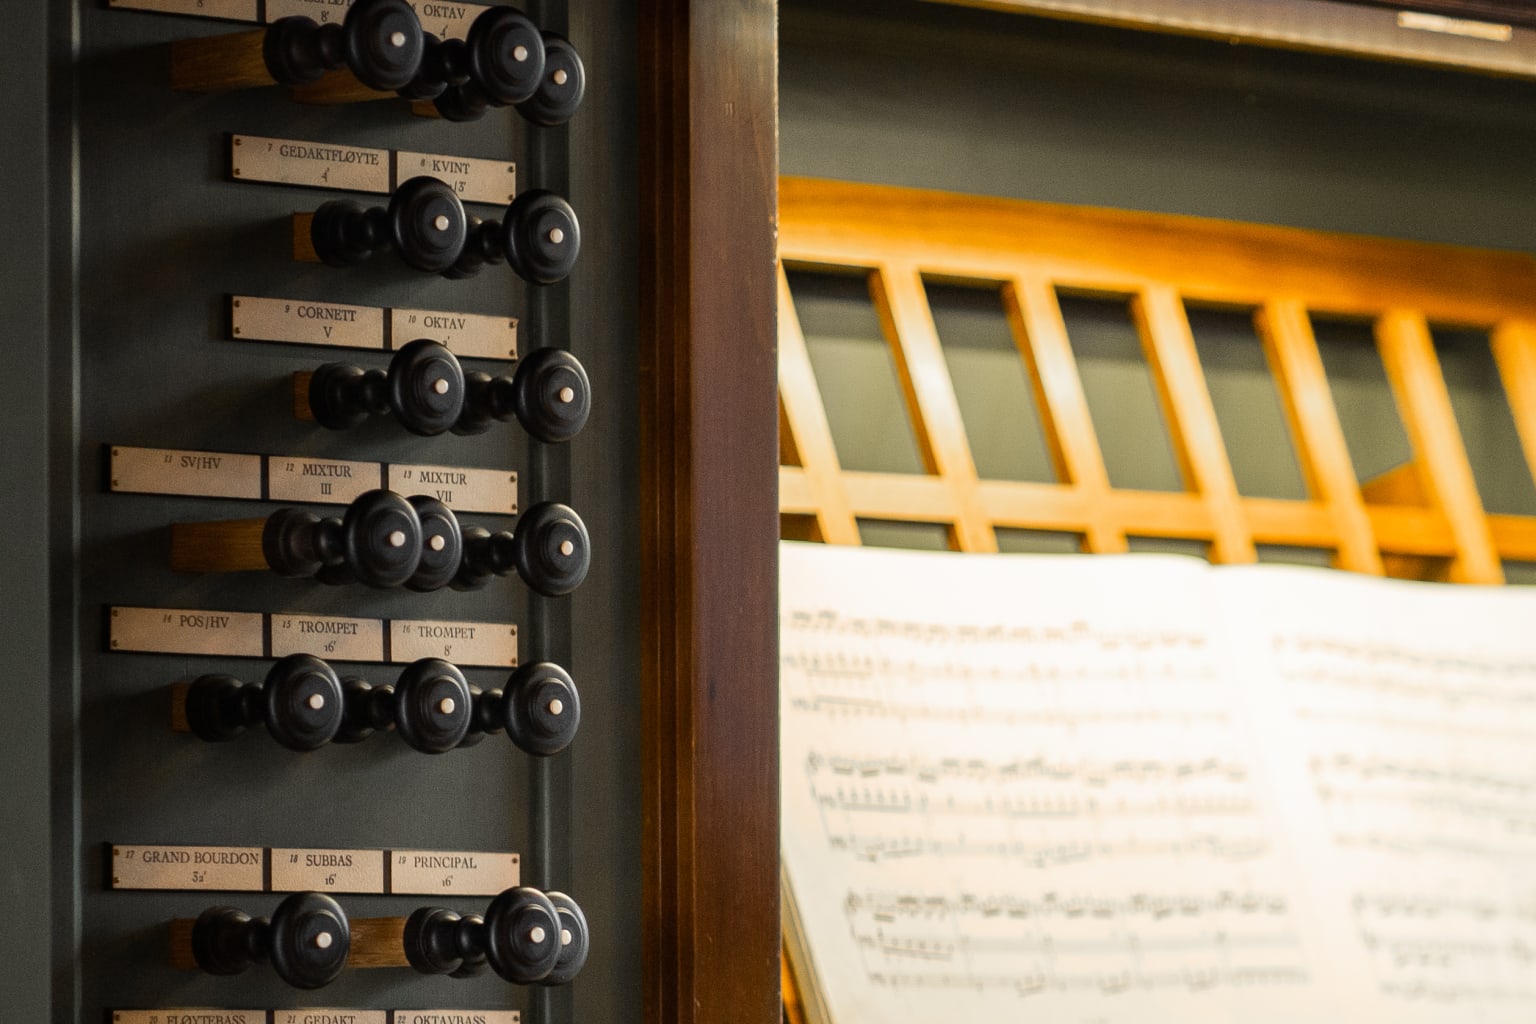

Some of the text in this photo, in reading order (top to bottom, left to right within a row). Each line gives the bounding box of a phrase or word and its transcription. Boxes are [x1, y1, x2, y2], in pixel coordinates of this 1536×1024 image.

[423, 4, 465, 19] OKTAV
[267, 142, 380, 166] 7 GEDAKTFLØYTE
[432, 159, 471, 175] KVINT
[297, 305, 357, 322] CORNETT
[408, 314, 466, 330] 10 OKTAV
[322, 325, 332, 338] V
[163, 454, 222, 470] 11 SV/HV
[285, 462, 352, 478] 12 MIXTUR
[419, 471, 467, 486] MIXTUR
[320, 482, 332, 496] III
[435, 489, 453, 503] VII
[179, 614, 230, 629] POS/HV
[281, 619, 359, 635] 15 TROMPET
[402, 624, 476, 640] 16 TROMPET
[125, 850, 259, 865] 17 GRAND BOURDON
[289, 854, 353, 867] 18 SUBBAS
[398, 855, 477, 869] 19 PRINCIPAL
[287, 1015, 296, 1024] 21
[397, 1015, 406, 1024] 22
